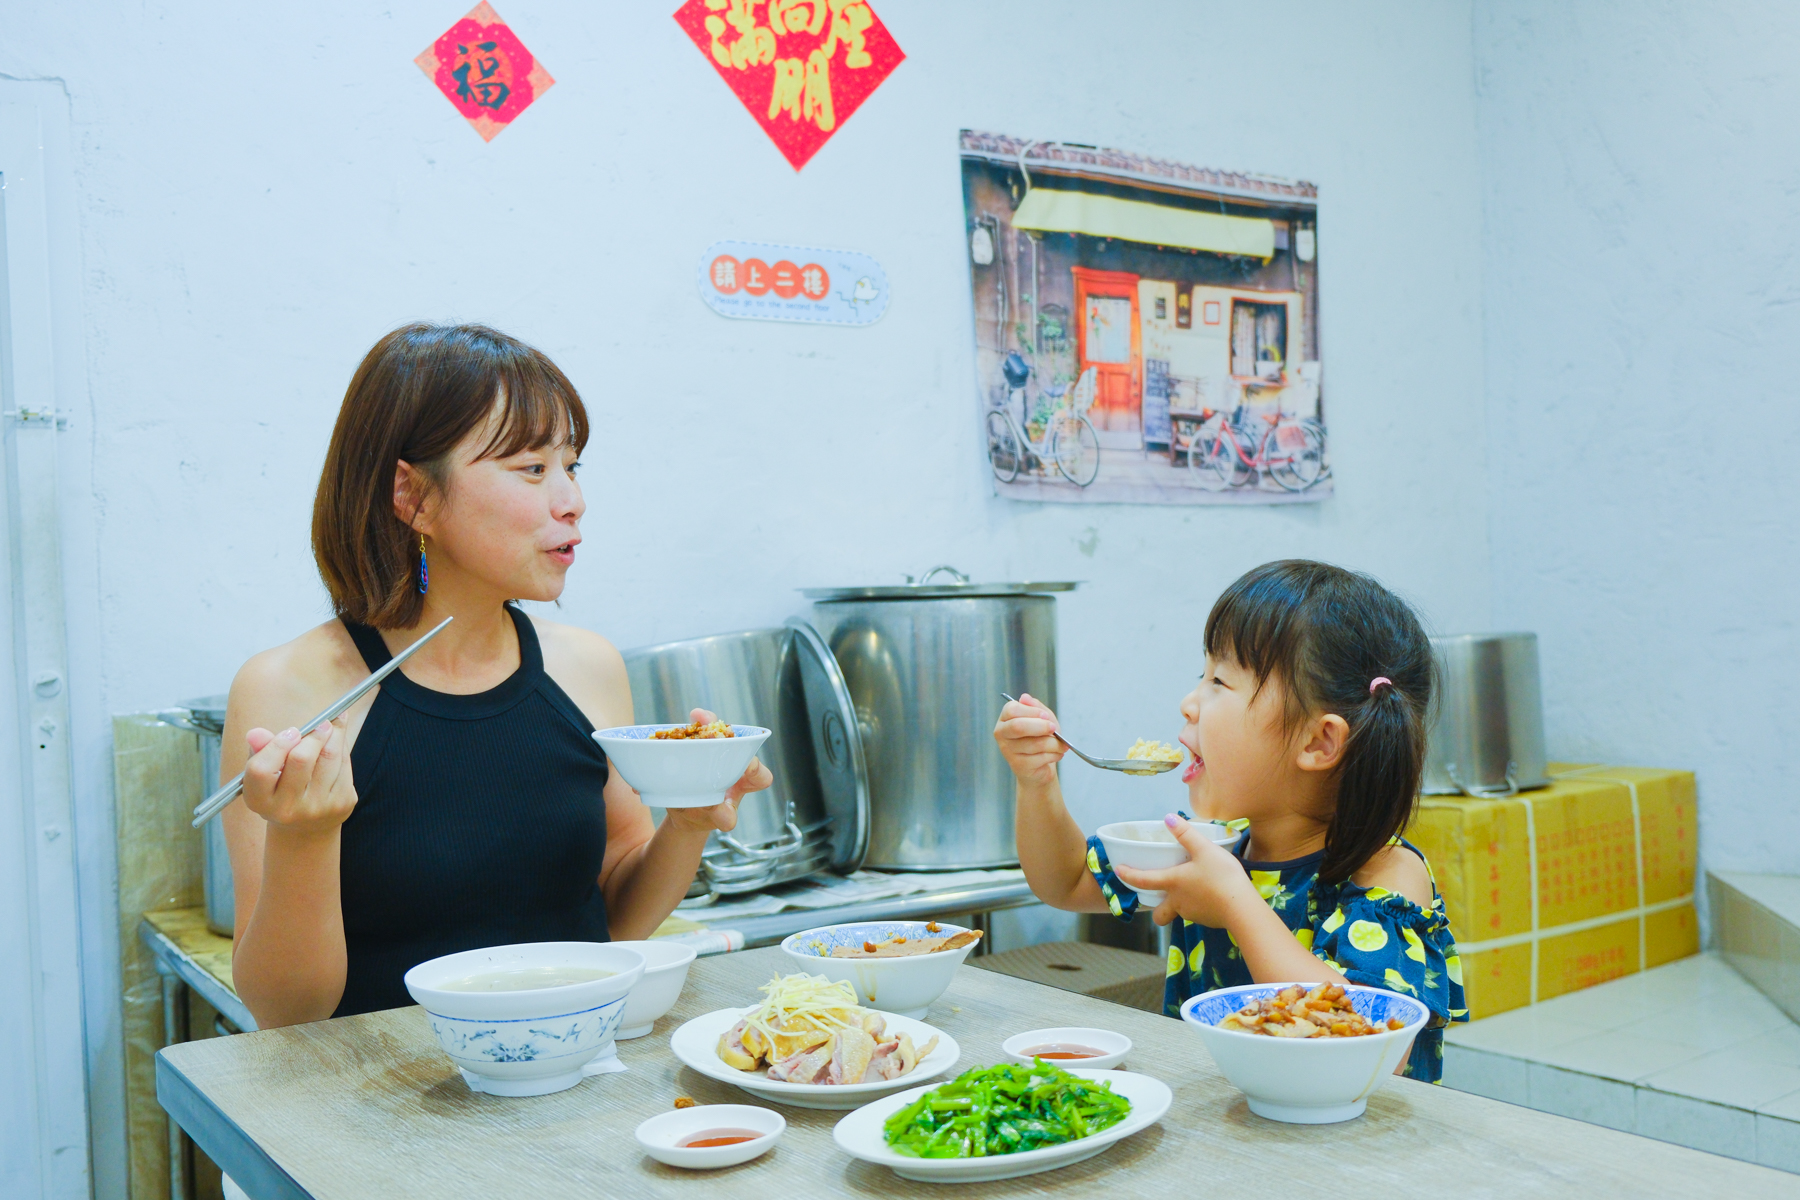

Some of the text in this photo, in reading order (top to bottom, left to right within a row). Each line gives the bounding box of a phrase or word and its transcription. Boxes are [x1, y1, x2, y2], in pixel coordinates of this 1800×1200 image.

[451, 41, 511, 111] 福
[714, 260, 825, 296] 請上二樓
[714, 295, 831, 312] Please go to the second floor
